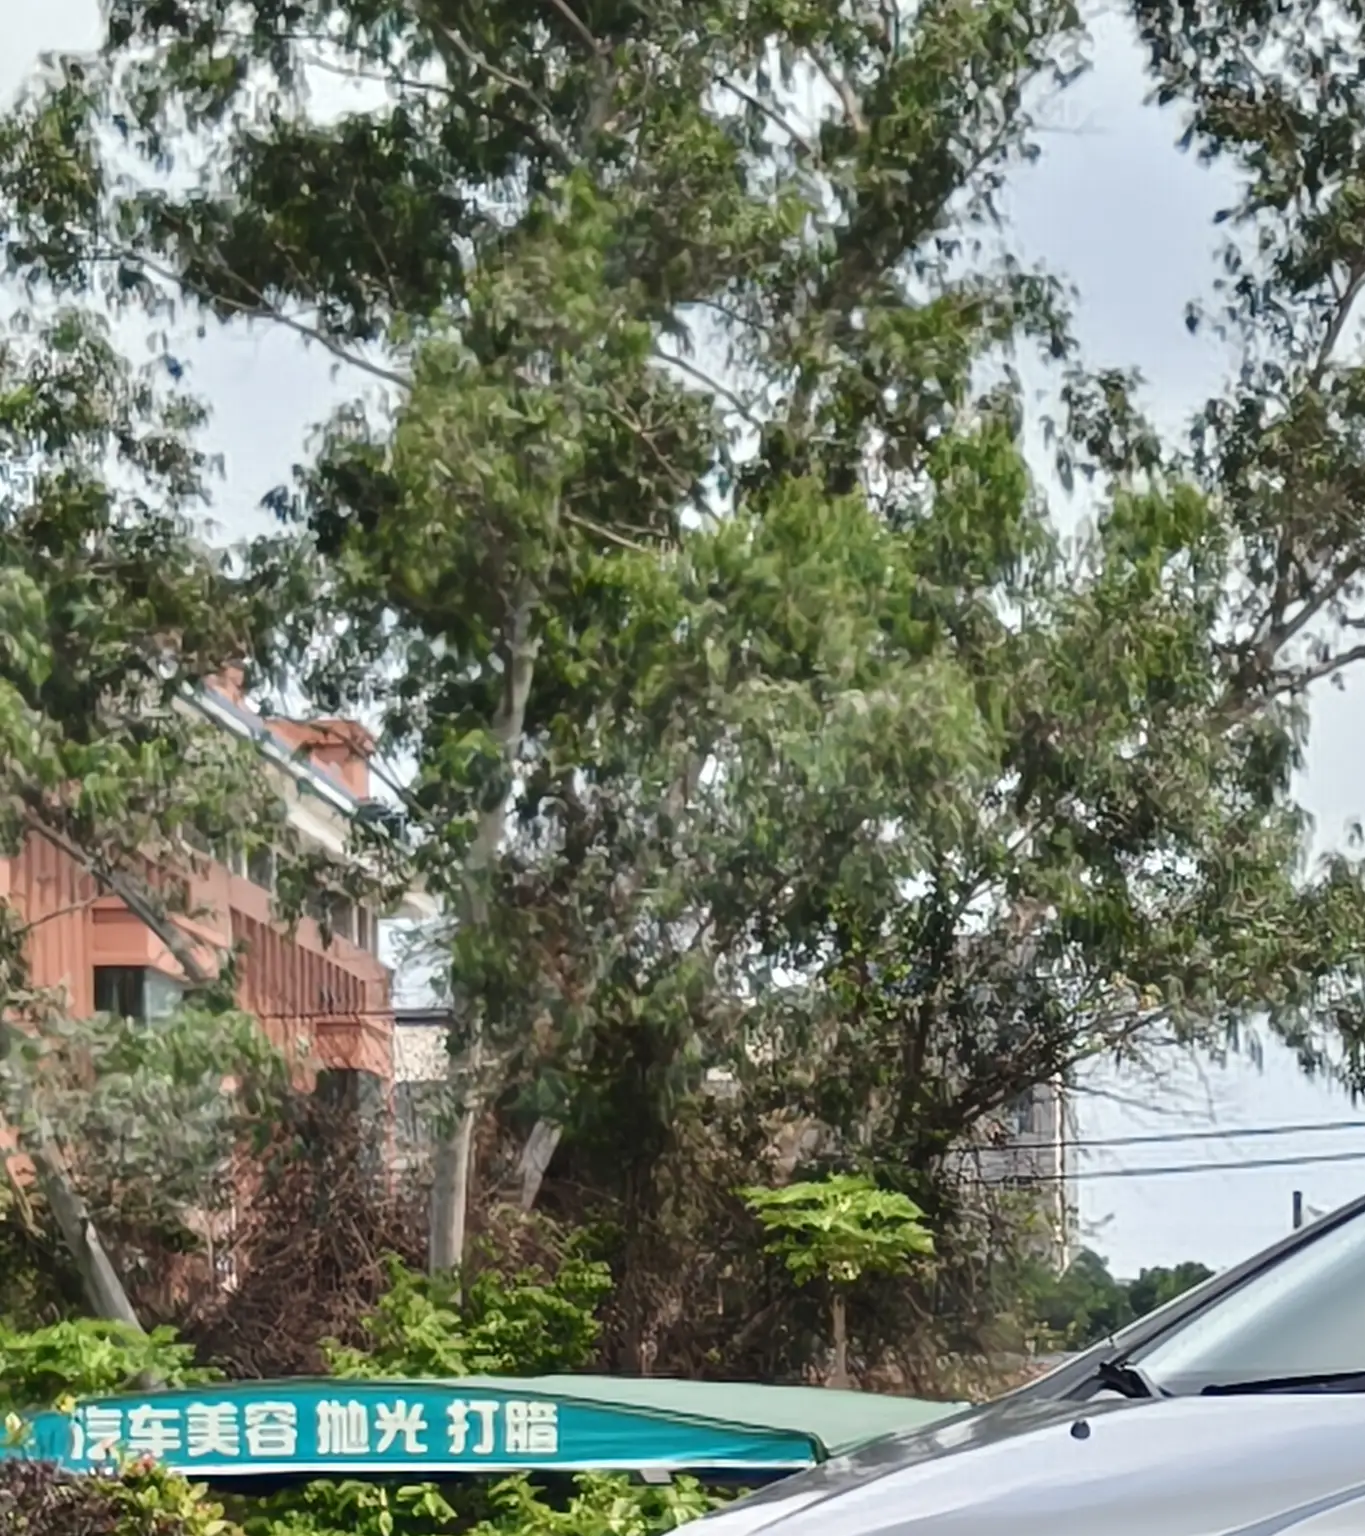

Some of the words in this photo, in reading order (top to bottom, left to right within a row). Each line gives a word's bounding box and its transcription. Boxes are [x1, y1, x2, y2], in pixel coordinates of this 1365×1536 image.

[70, 1401, 298, 1460] 汽车美容
[316, 1399, 429, 1454] 抛光
